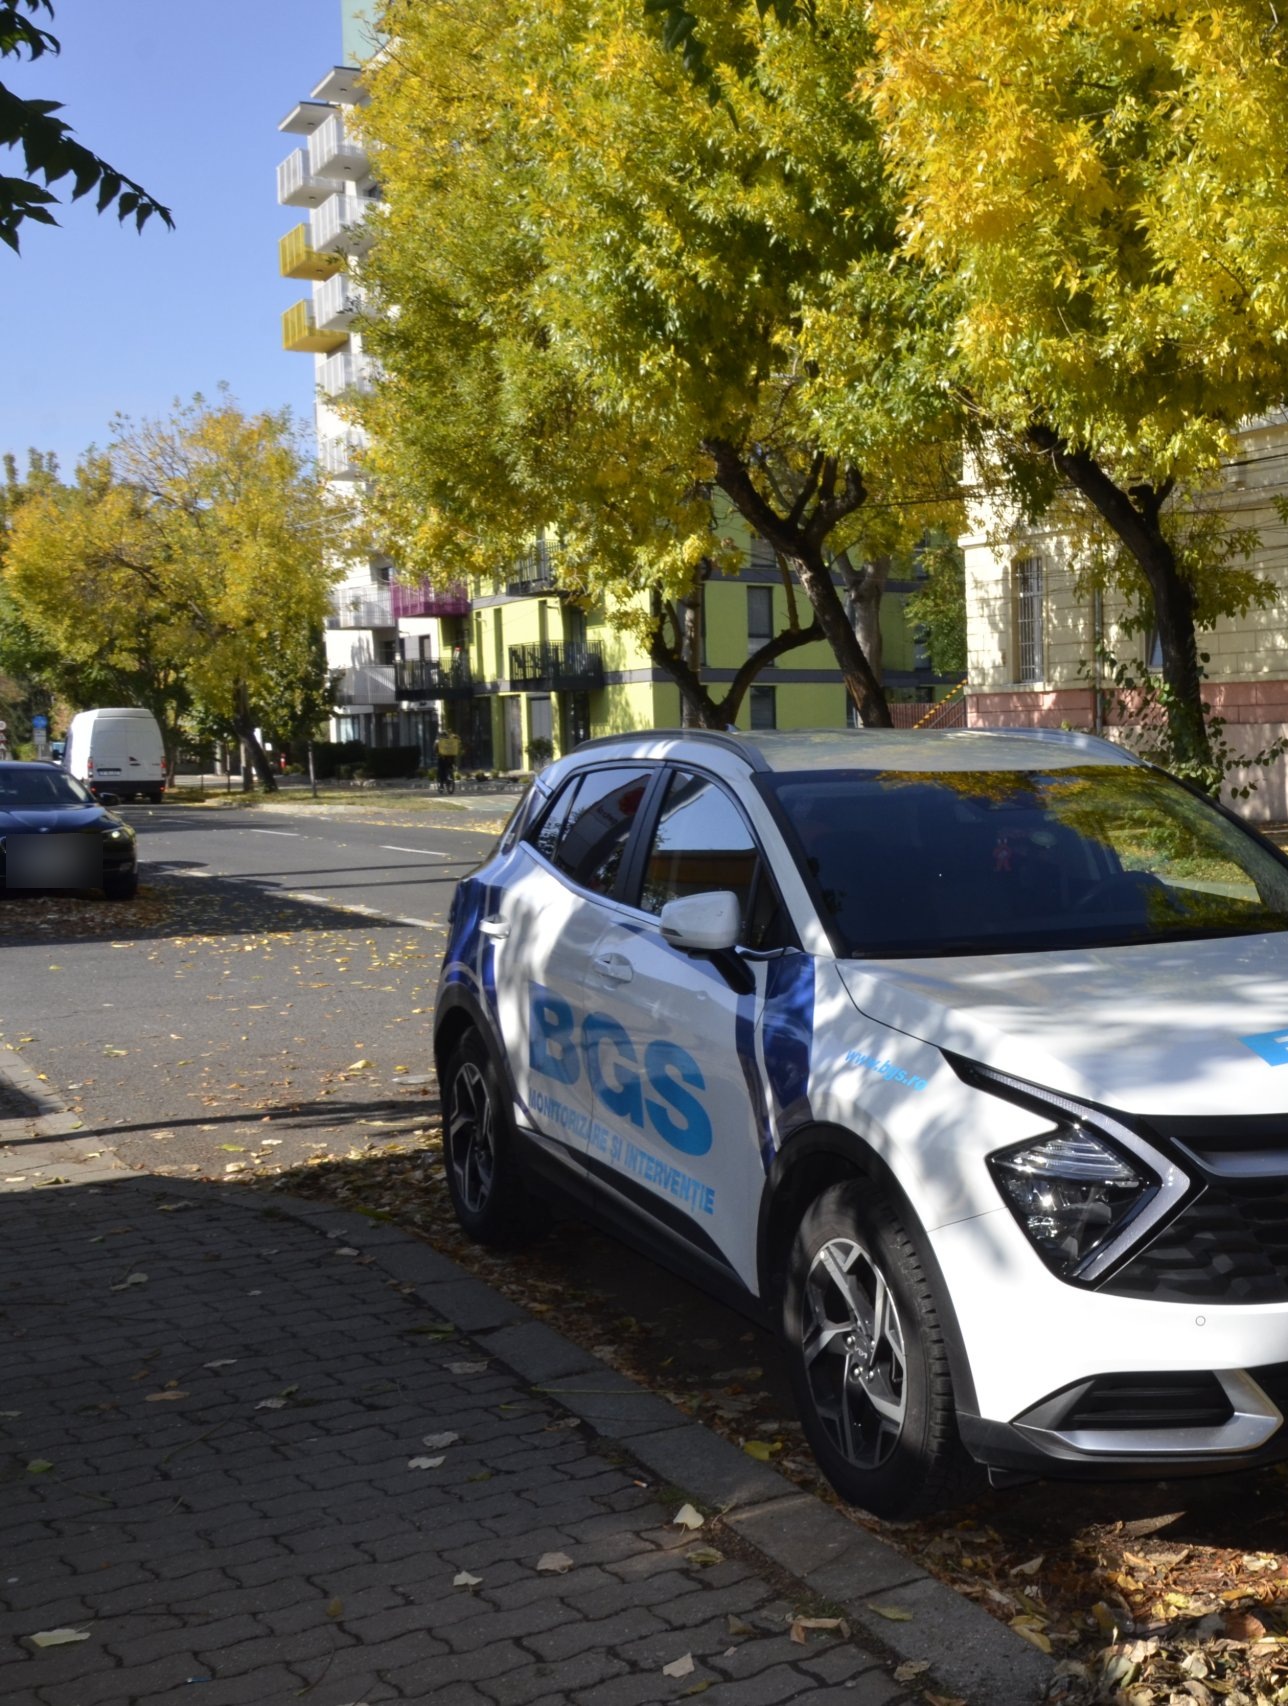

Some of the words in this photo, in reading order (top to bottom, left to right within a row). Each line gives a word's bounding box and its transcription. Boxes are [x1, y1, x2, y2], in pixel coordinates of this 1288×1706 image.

[528, 980, 713, 1157] BGS
[845, 1049, 929, 1092] www.bgs.ro
[528, 1086, 609, 1153] MONITORIZARE
